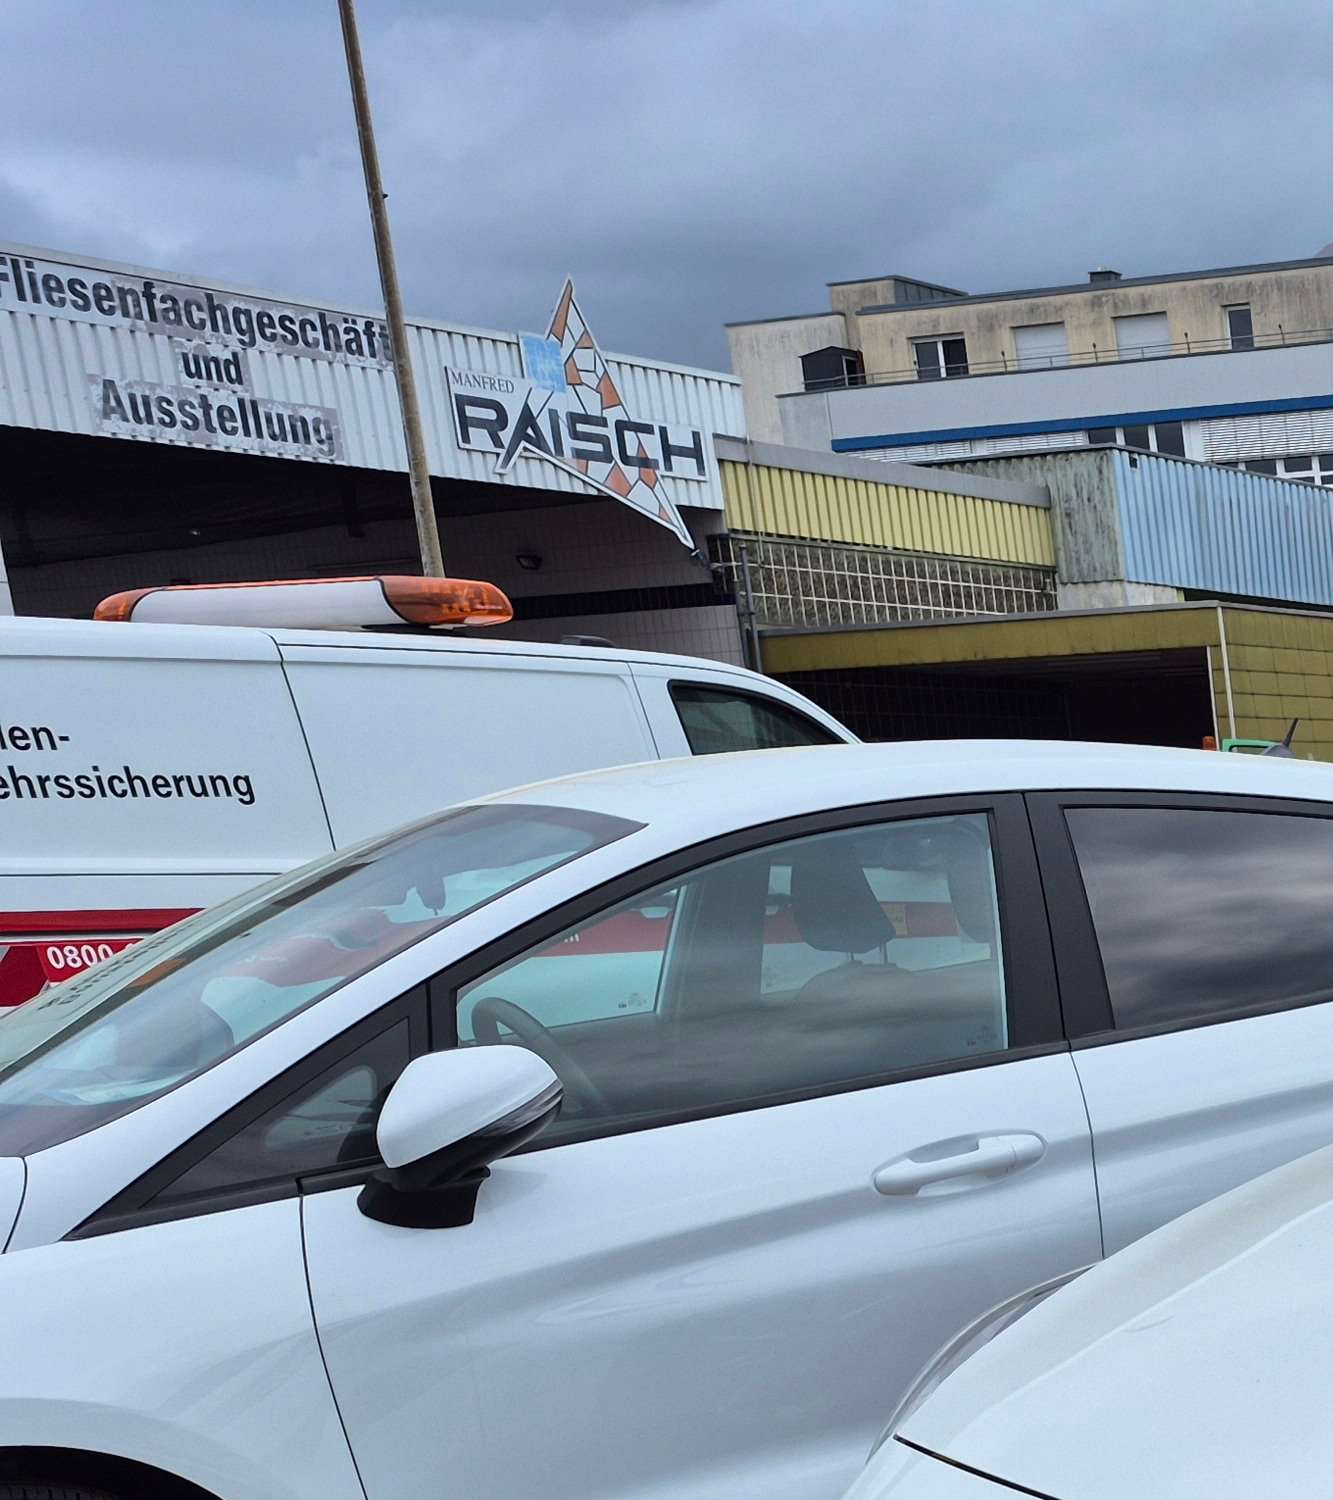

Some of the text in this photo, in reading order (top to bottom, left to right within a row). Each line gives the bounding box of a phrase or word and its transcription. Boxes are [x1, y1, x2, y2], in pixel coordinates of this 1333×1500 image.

[181, 351, 244, 385] und
[451, 371, 514, 394] MANFRED
[101, 379, 336, 457] Ausstellung
[455, 392, 706, 477] RAISCH
[46, 944, 113, 969] 0800
